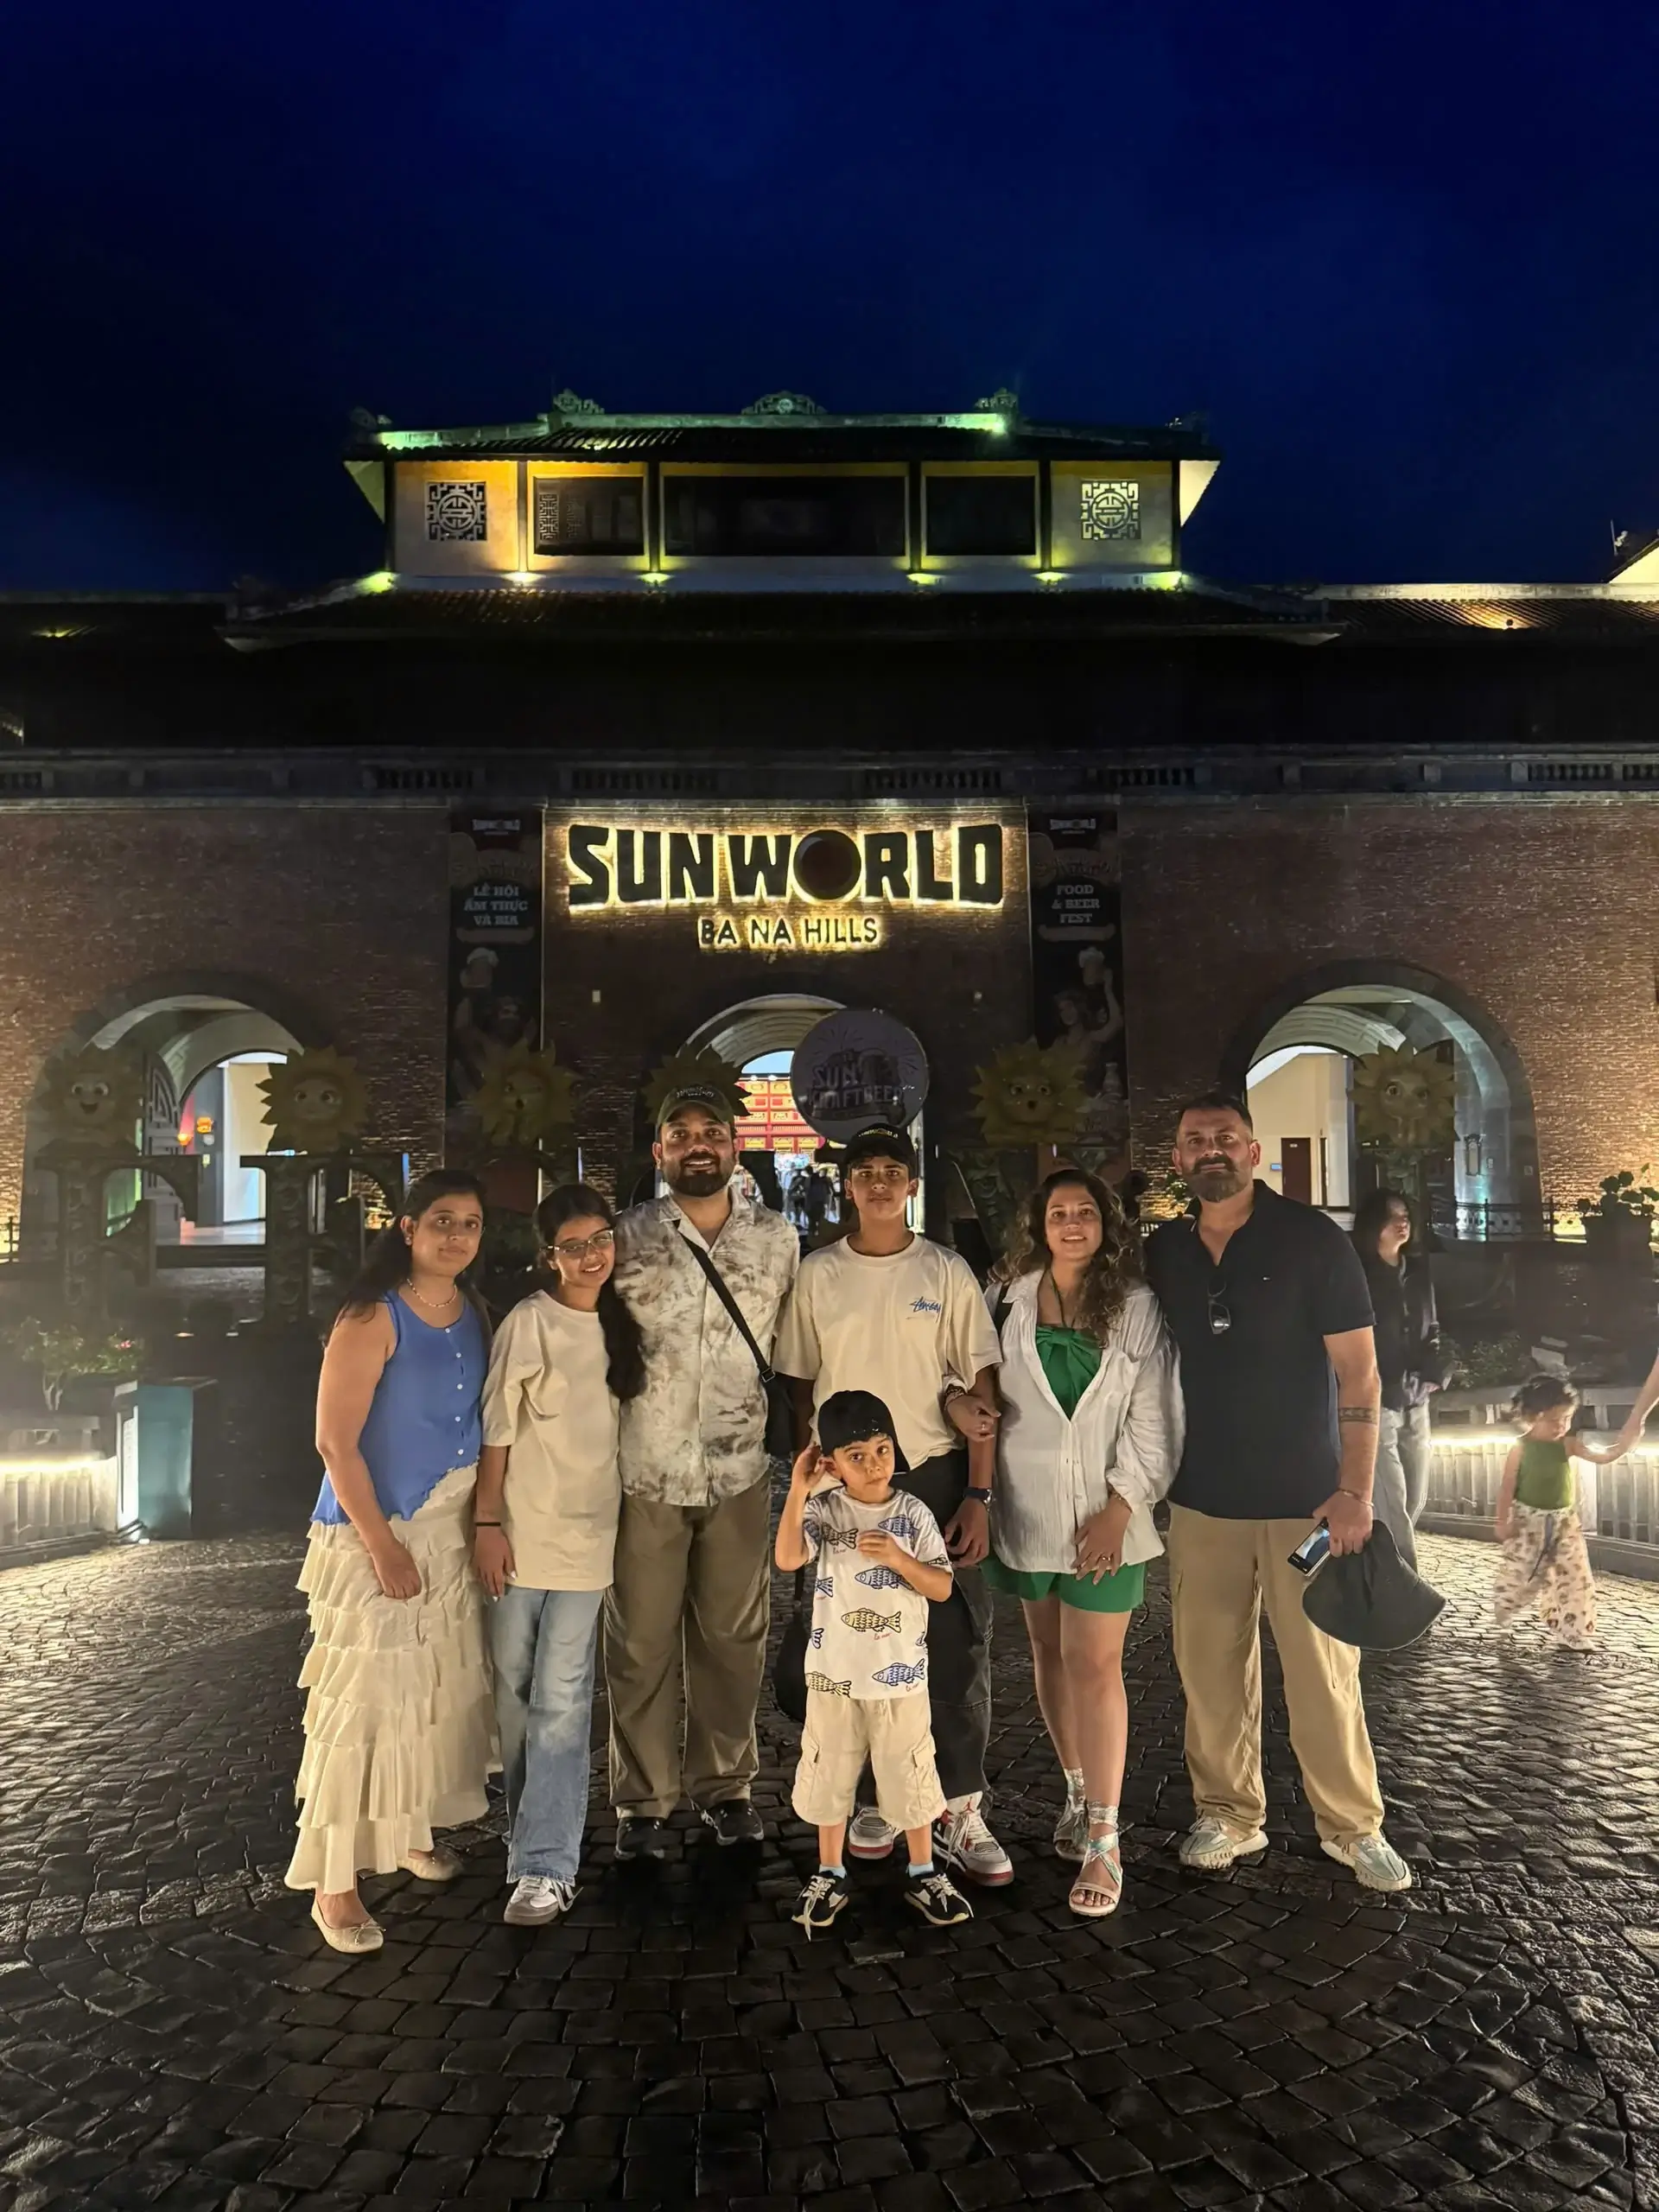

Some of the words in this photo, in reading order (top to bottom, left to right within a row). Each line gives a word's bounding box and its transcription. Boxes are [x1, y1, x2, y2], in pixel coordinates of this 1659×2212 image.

[1057, 885, 1095, 895] FOOD
[1051, 899, 1062, 910] &
[1065, 899, 1101, 909] BEER
[1059, 913, 1093, 925] FEST
[701, 918, 737, 944] BA
[751, 918, 791, 944] NA
[804, 918, 878, 944] HILLS
